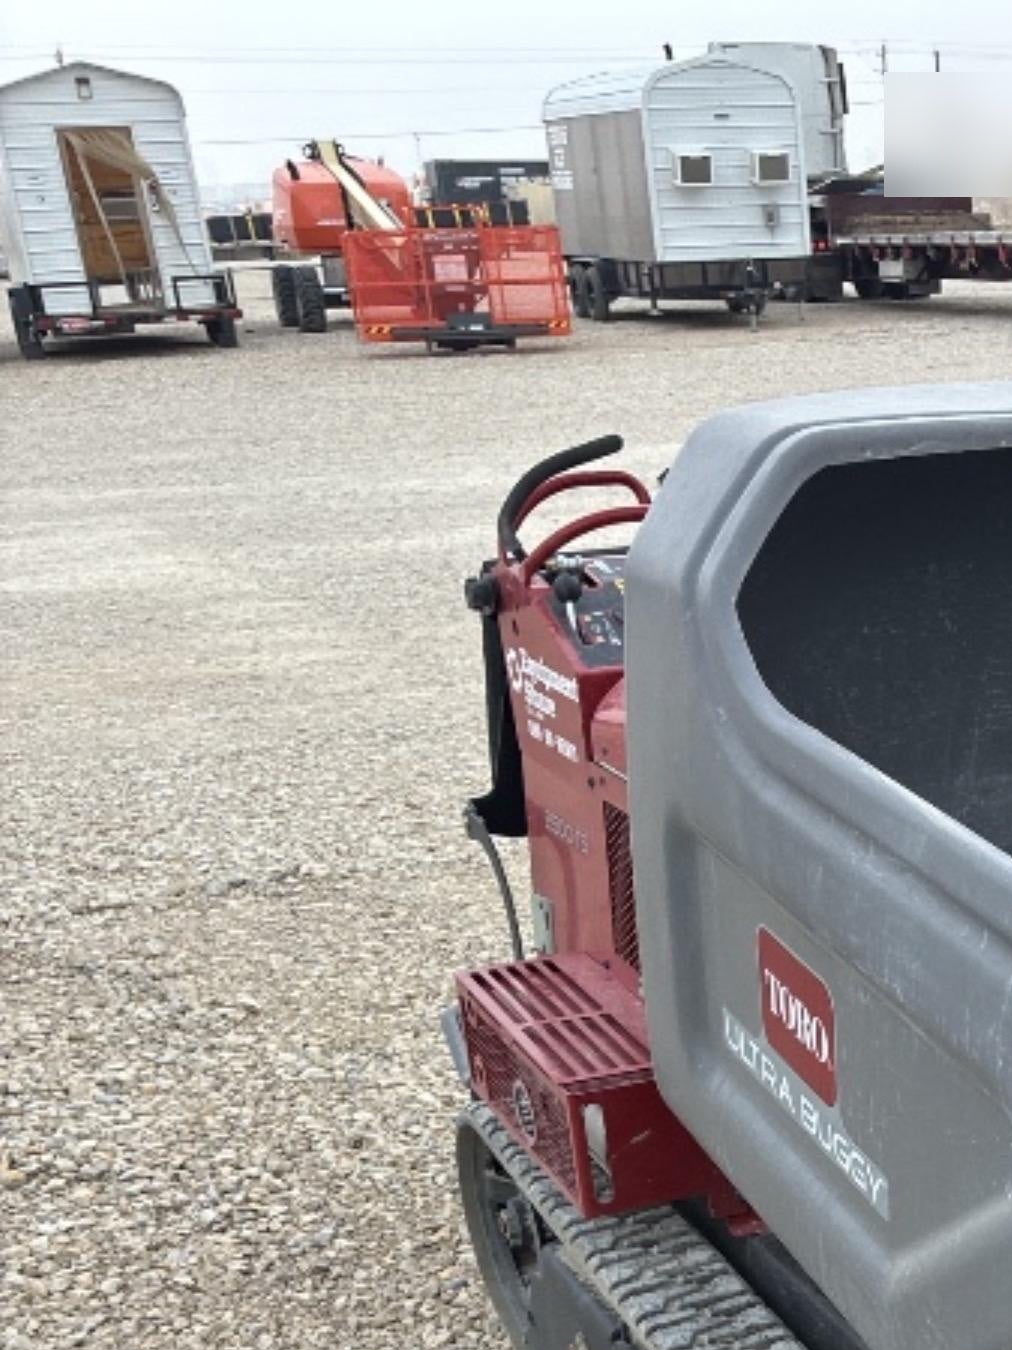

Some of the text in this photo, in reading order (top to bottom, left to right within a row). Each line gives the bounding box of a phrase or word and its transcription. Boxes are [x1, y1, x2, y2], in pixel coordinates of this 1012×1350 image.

[764, 967, 831, 1065] TORO
[721, 1006, 886, 1205] ULTRA BUGGY
